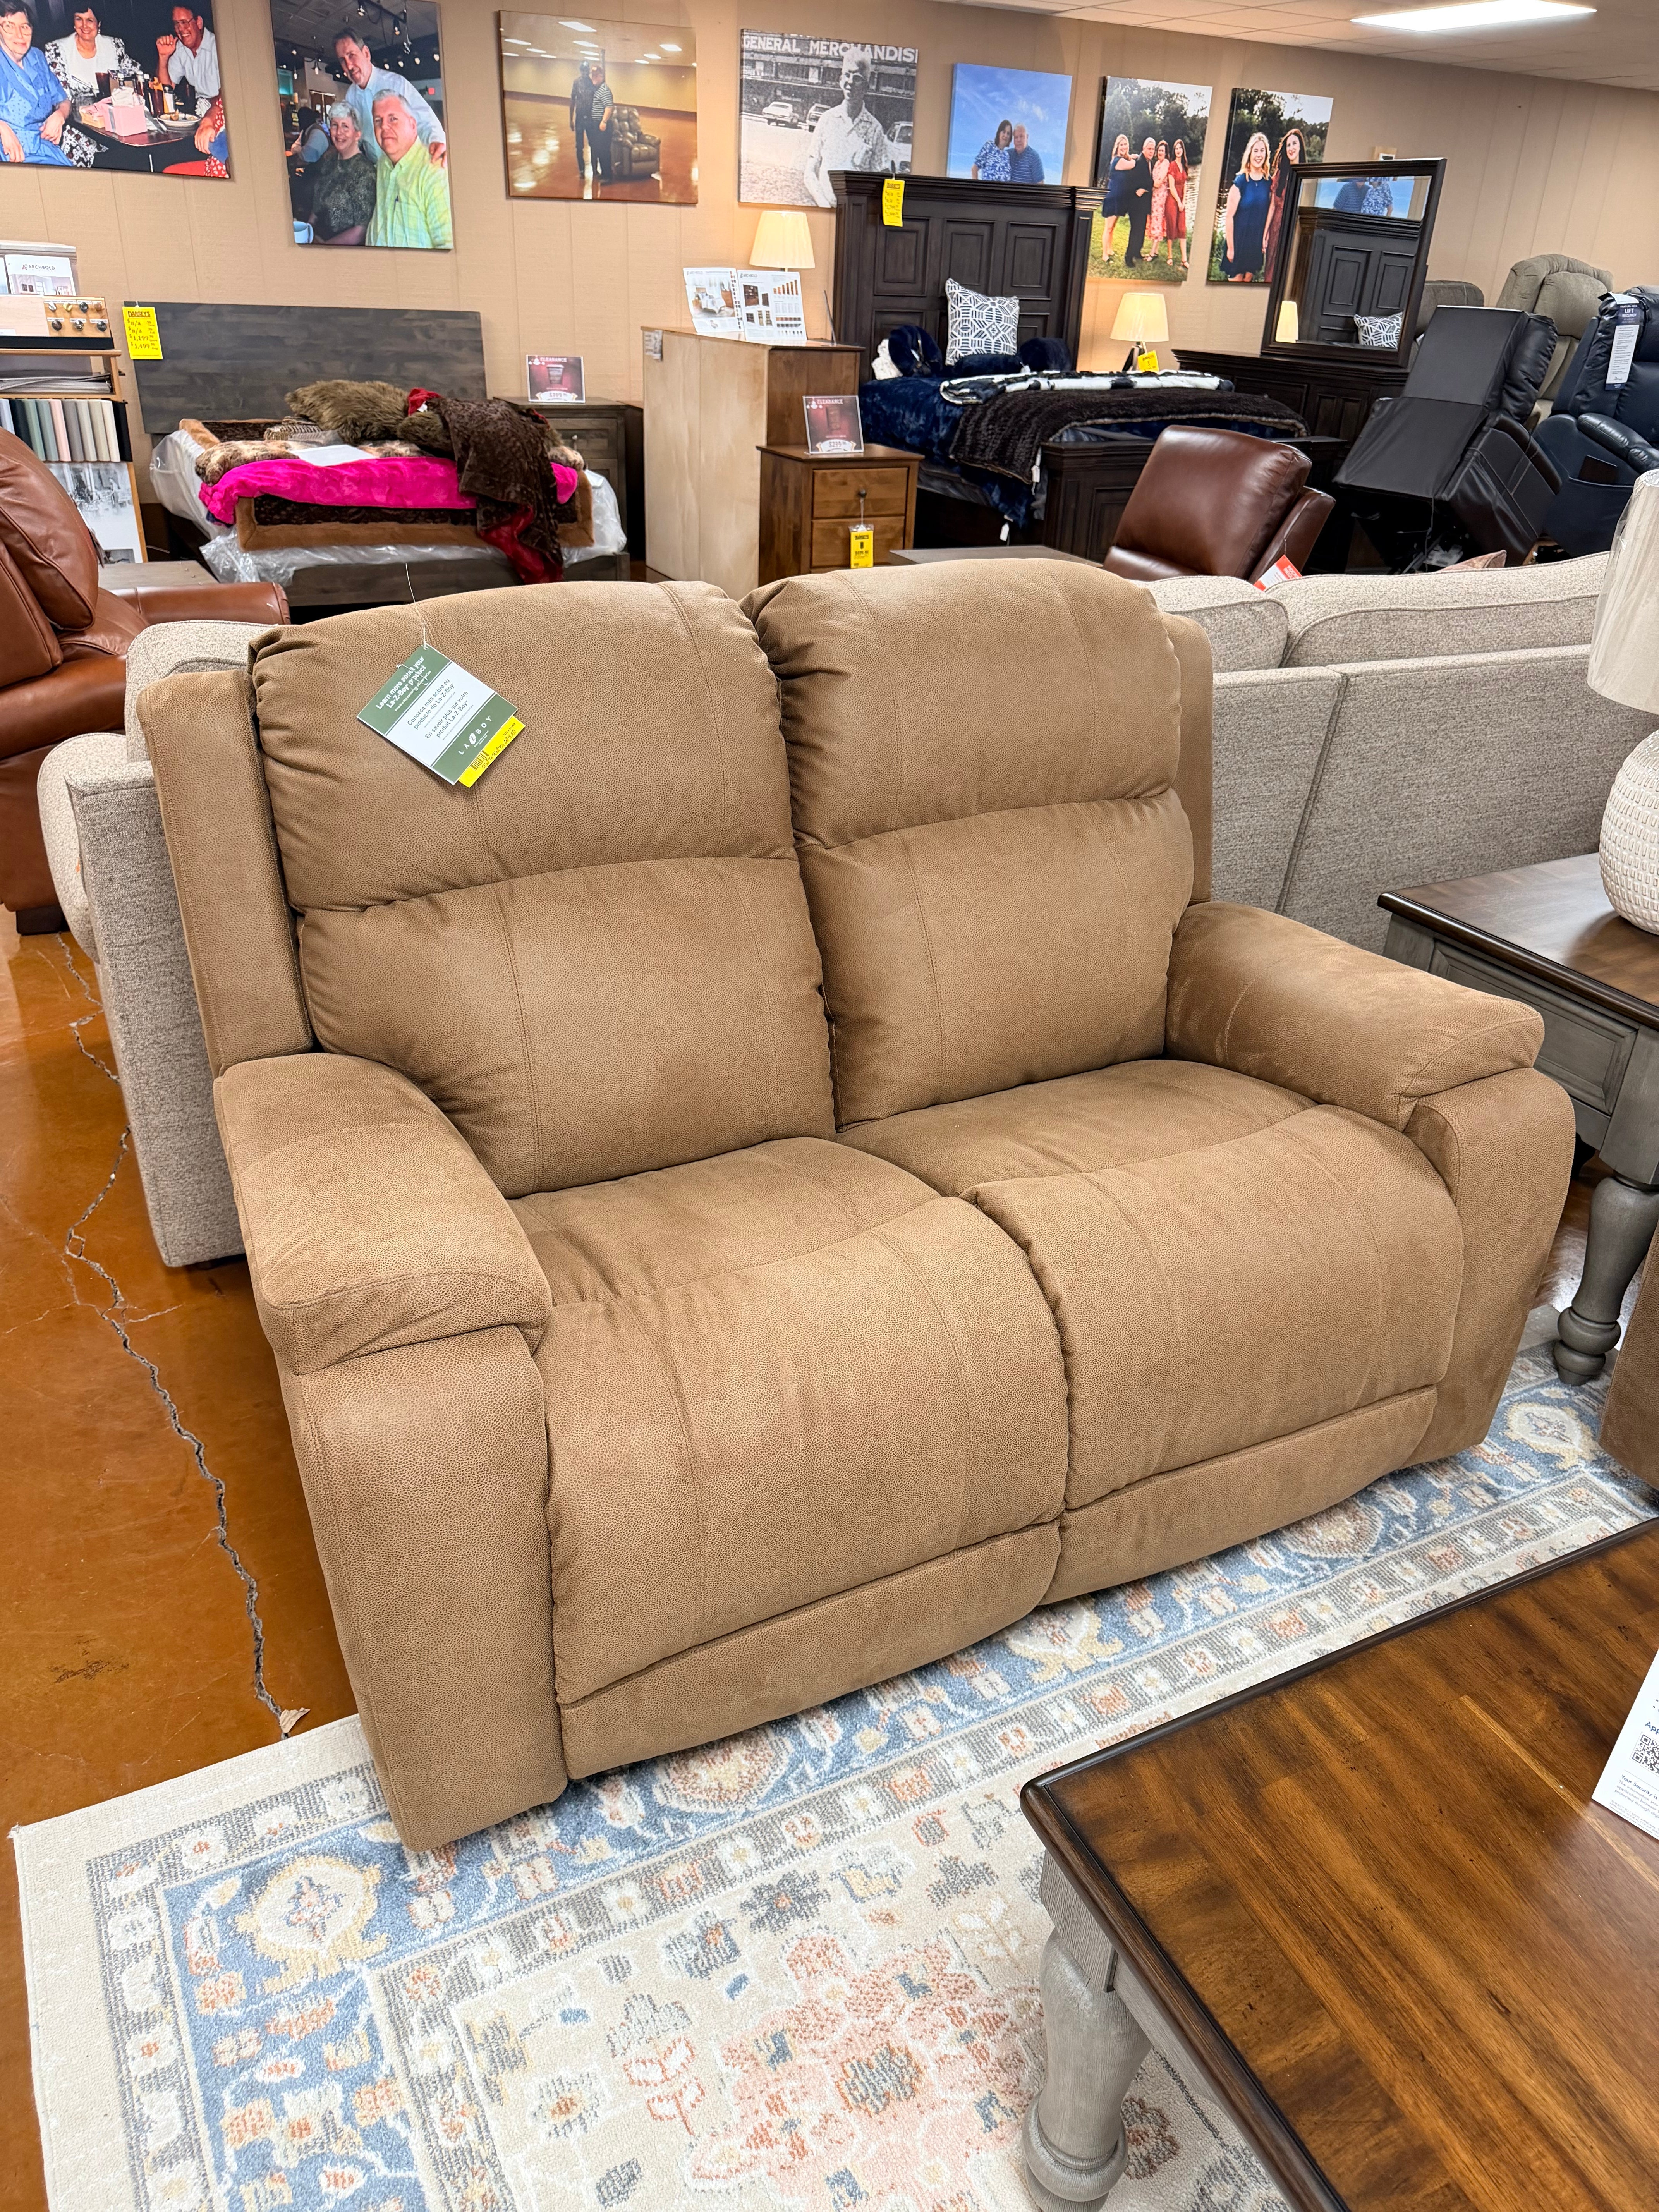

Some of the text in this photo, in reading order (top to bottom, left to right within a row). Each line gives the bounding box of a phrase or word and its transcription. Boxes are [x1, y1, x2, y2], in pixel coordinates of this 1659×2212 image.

[743, 35, 801, 53] GENERAL
[375, 694, 392, 709] Learn
[389, 681, 403, 695] more
[413, 656, 425, 669] your
[407, 706, 426, 725] Conozca
[424, 697, 434, 707] más
[433, 685, 445, 697] sobre
[431, 719, 443, 732] savoir
[443, 709, 452, 720] plus
[457, 691, 468, 702] votre
[414, 709, 432, 730] producto
[436, 721, 451, 738] produit
[1622, 1774, 1632, 1783] Your
[1633, 1782, 1653, 1797] Security
[1627, 1786, 1650, 1802] information
[1614, 1790, 1634, 1802] protected
[1635, 1801, 1650, 1812] through
[1616, 1785, 1657, 1810] application browser
